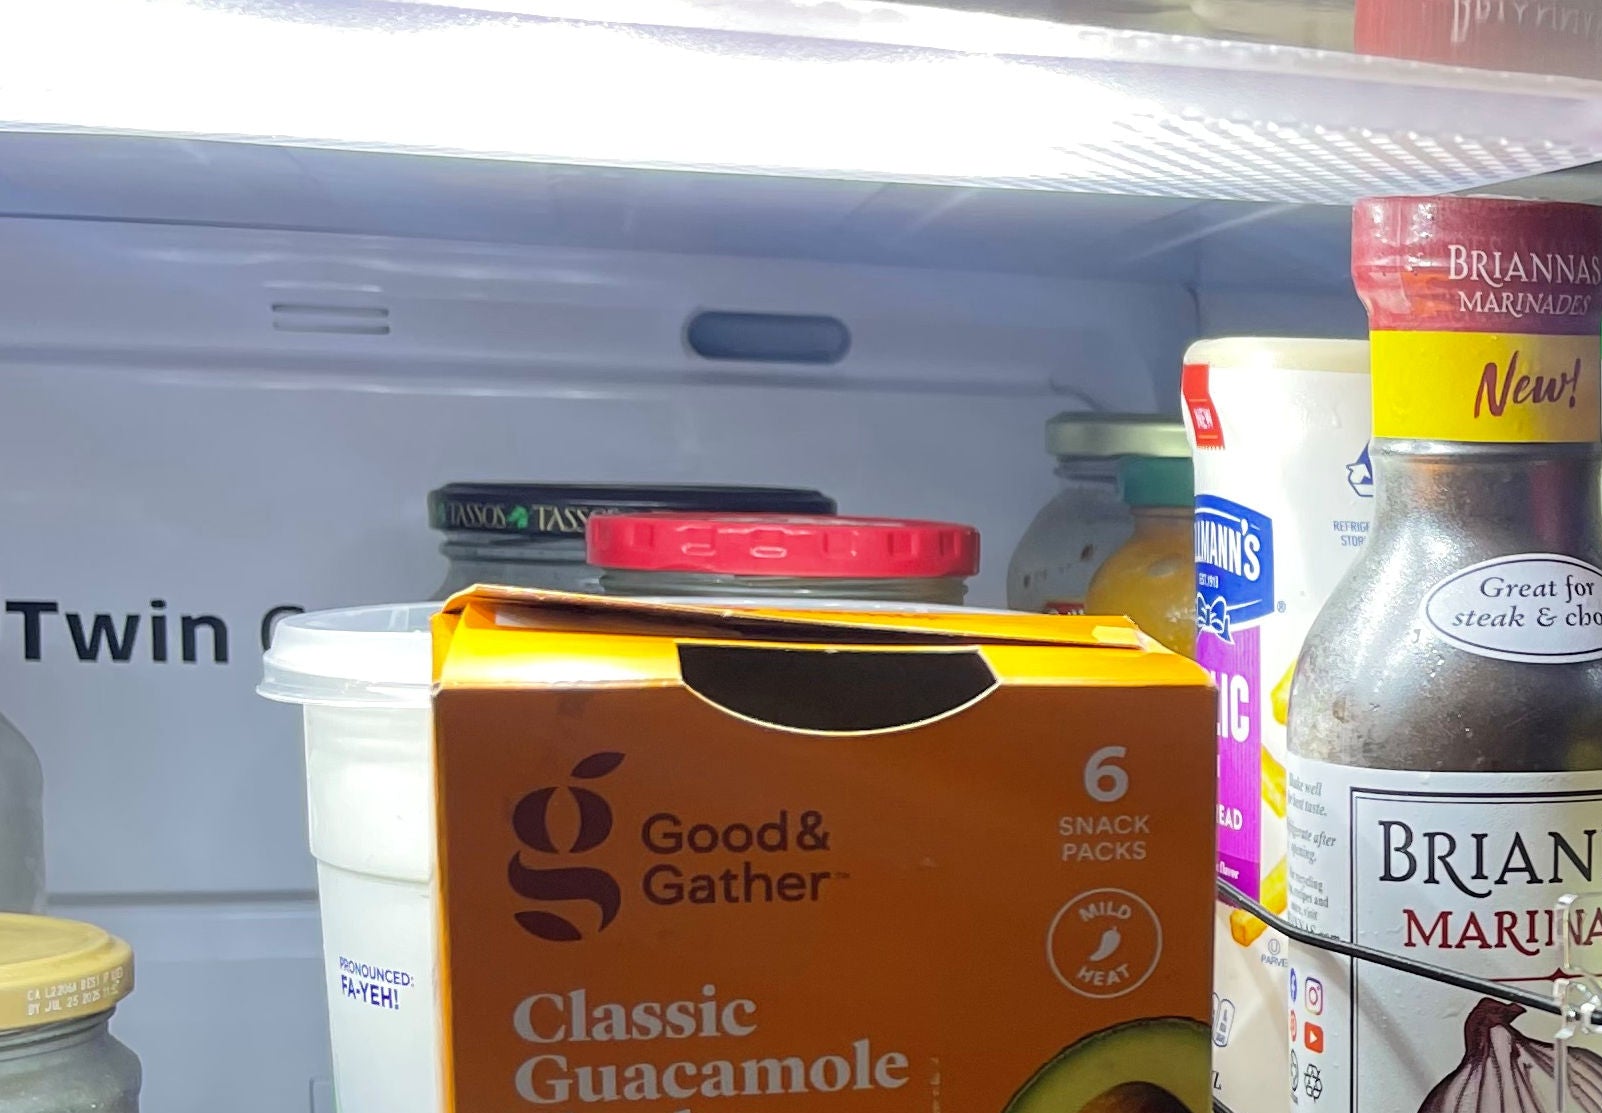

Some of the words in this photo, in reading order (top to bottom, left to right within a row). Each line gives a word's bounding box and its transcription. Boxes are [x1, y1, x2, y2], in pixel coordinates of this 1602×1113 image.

[1448, 244, 1601, 288] BRIANNAS
[1458, 290, 1592, 318] MARINADES
[1474, 350, 1582, 419] New!
[449, 505, 507, 529] TASSOS
[532, 504, 622, 533] TASS
[1480, 576, 1557, 598] Great
[1565, 574, 1595, 604] for
[1452, 604, 1525, 628] steak
[1537, 606, 1558, 628] &
[5, 600, 230, 665] Twin
[1084, 745, 1130, 802] 6
[1058, 815, 1151, 837] SNACK
[1216, 804, 1243, 831] EAD
[1062, 841, 1148, 862] PACKS
[1313, 831, 1337, 848] after
[642, 861, 831, 906] Gather
[1078, 900, 1132, 923] MILD
[339, 956, 415, 988] PRONOUNCED:
[1076, 963, 1131, 986] HEAT
[1260, 955, 1288, 968] PARVE
[45, 999, 62, 1013] JUL
[66, 994, 79, 1008] 25
[341, 974, 399, 1010] FA-YEH!
[513, 985, 758, 1044] Classic
[514, 1038, 910, 1104] Guacamole
